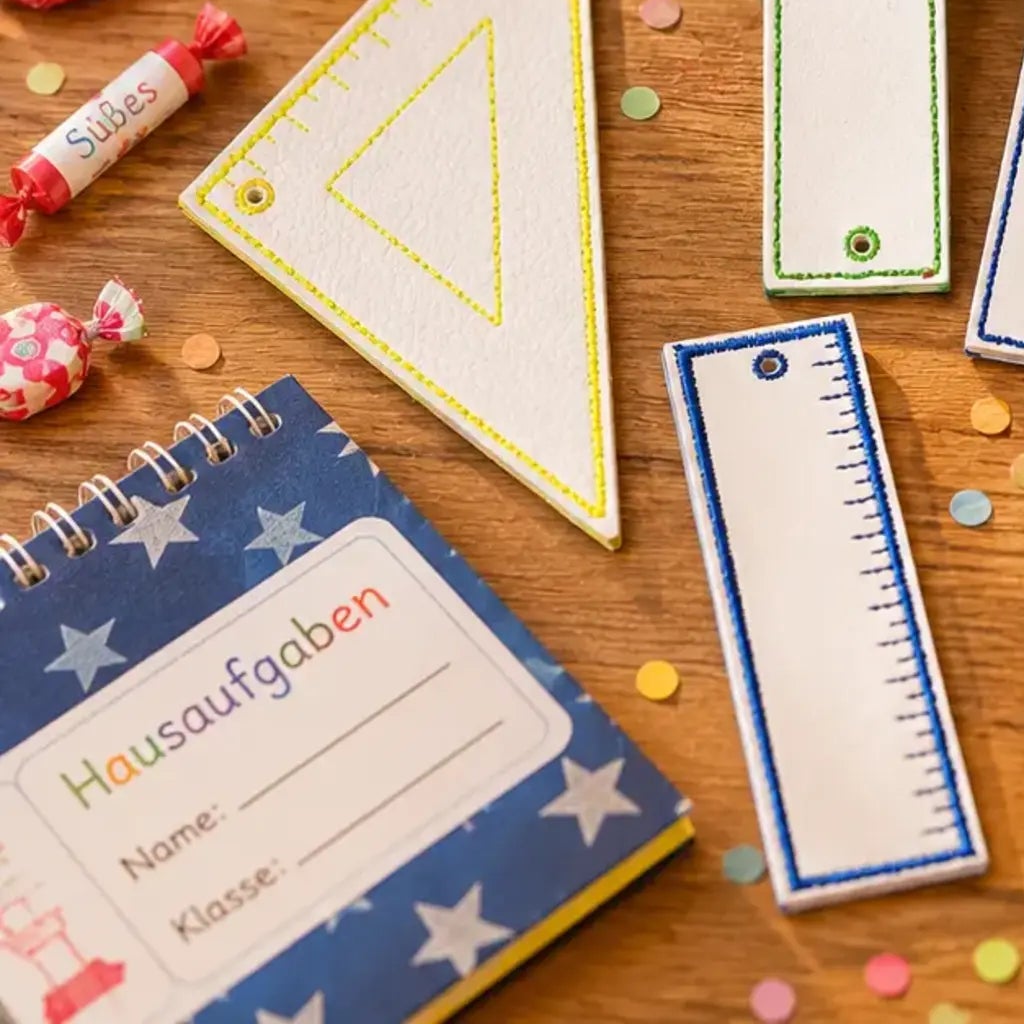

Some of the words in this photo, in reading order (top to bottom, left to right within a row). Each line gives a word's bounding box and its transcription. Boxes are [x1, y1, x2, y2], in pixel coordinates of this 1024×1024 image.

[60, 586, 390, 810] Hausaufgaben
[119, 803, 226, 882] Name:
[169, 857, 287, 944] Klasse:
